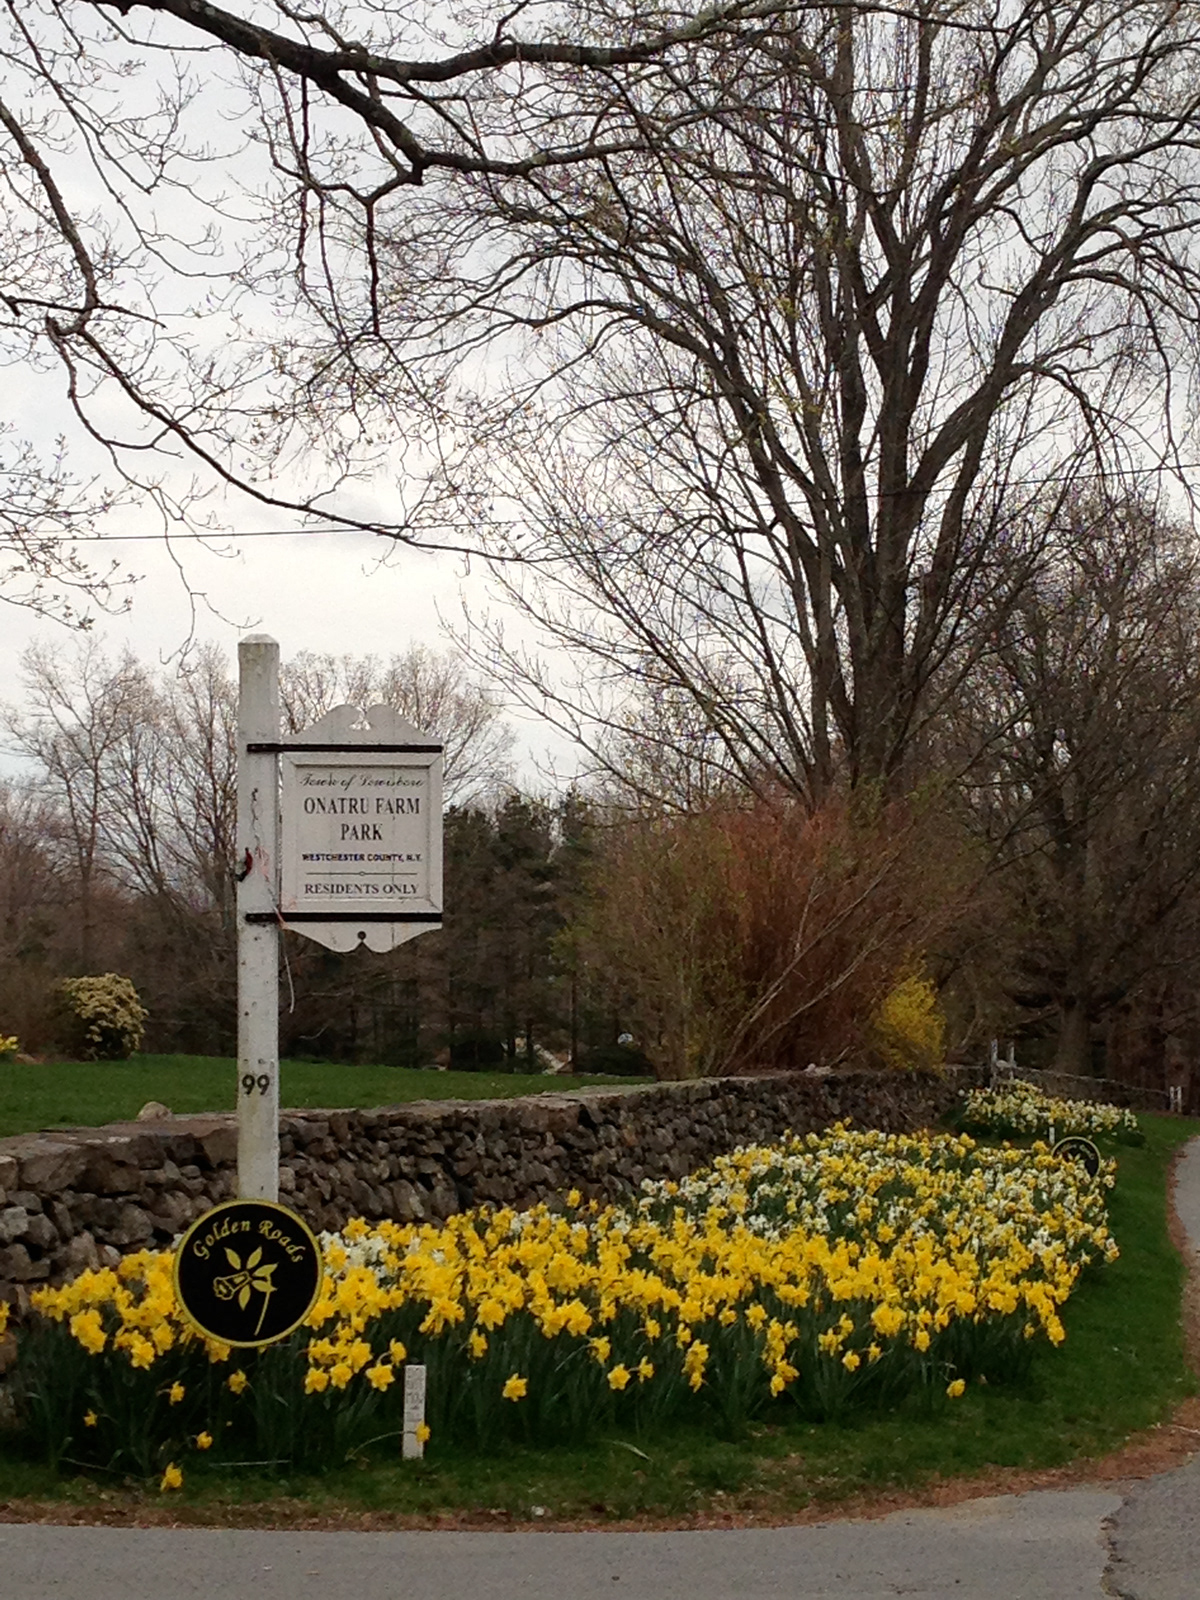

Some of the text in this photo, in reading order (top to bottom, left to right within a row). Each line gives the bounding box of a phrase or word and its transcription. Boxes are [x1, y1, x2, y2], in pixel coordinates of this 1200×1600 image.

[340, 774, 357, 791] of
[304, 797, 420, 814] ONATRU FARM
[341, 823, 383, 840] PARK
[302, 853, 365, 861] WESTCHESTER
[367, 853, 404, 863] COUNTY,
[304, 883, 418, 894] RESIDENTS ONLY
[242, 1074, 270, 1095] 99
[193, 1216, 306, 1262] Golden Roads
